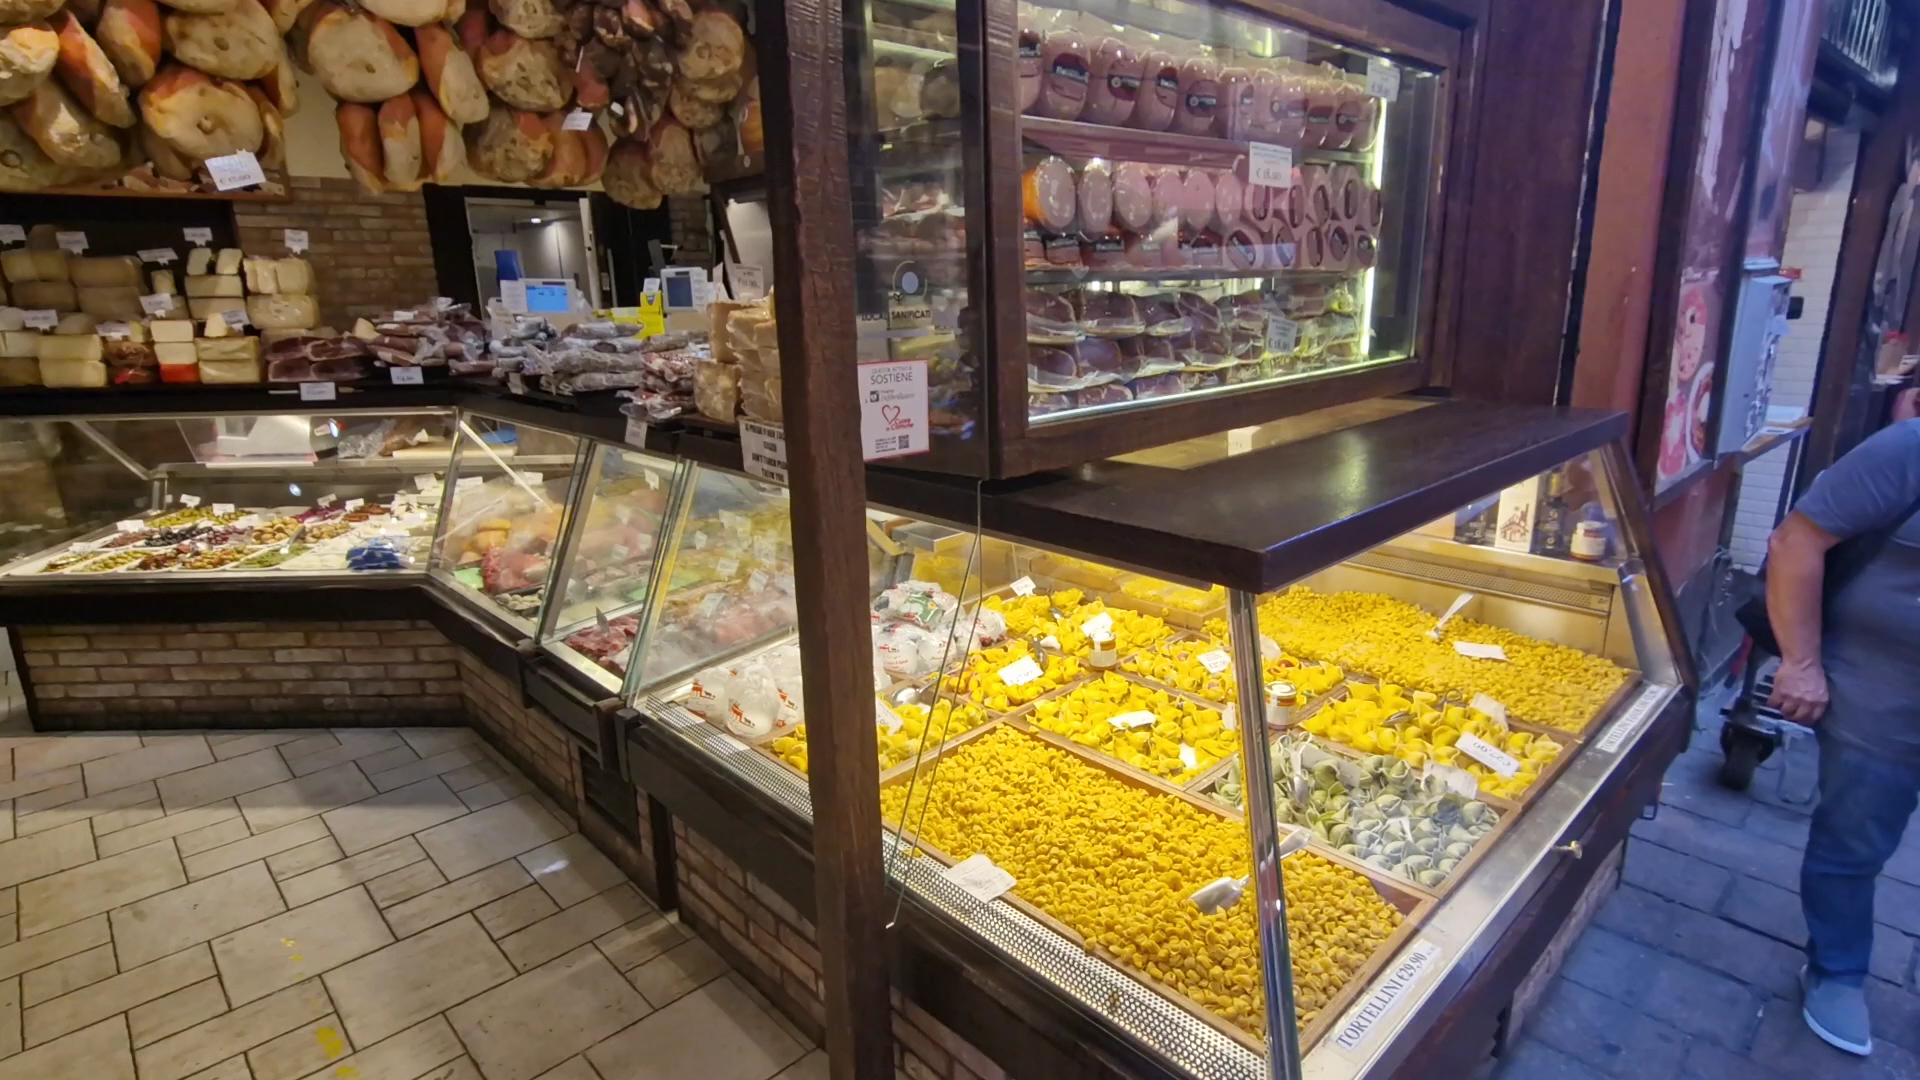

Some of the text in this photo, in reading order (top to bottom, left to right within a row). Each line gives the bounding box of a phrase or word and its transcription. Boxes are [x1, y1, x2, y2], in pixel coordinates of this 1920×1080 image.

[891, 309, 931, 320] SANIFICATI
[870, 372, 913, 385] SOSTIENE
[1336, 952, 1427, 1048] TORTELLINI €29,90
